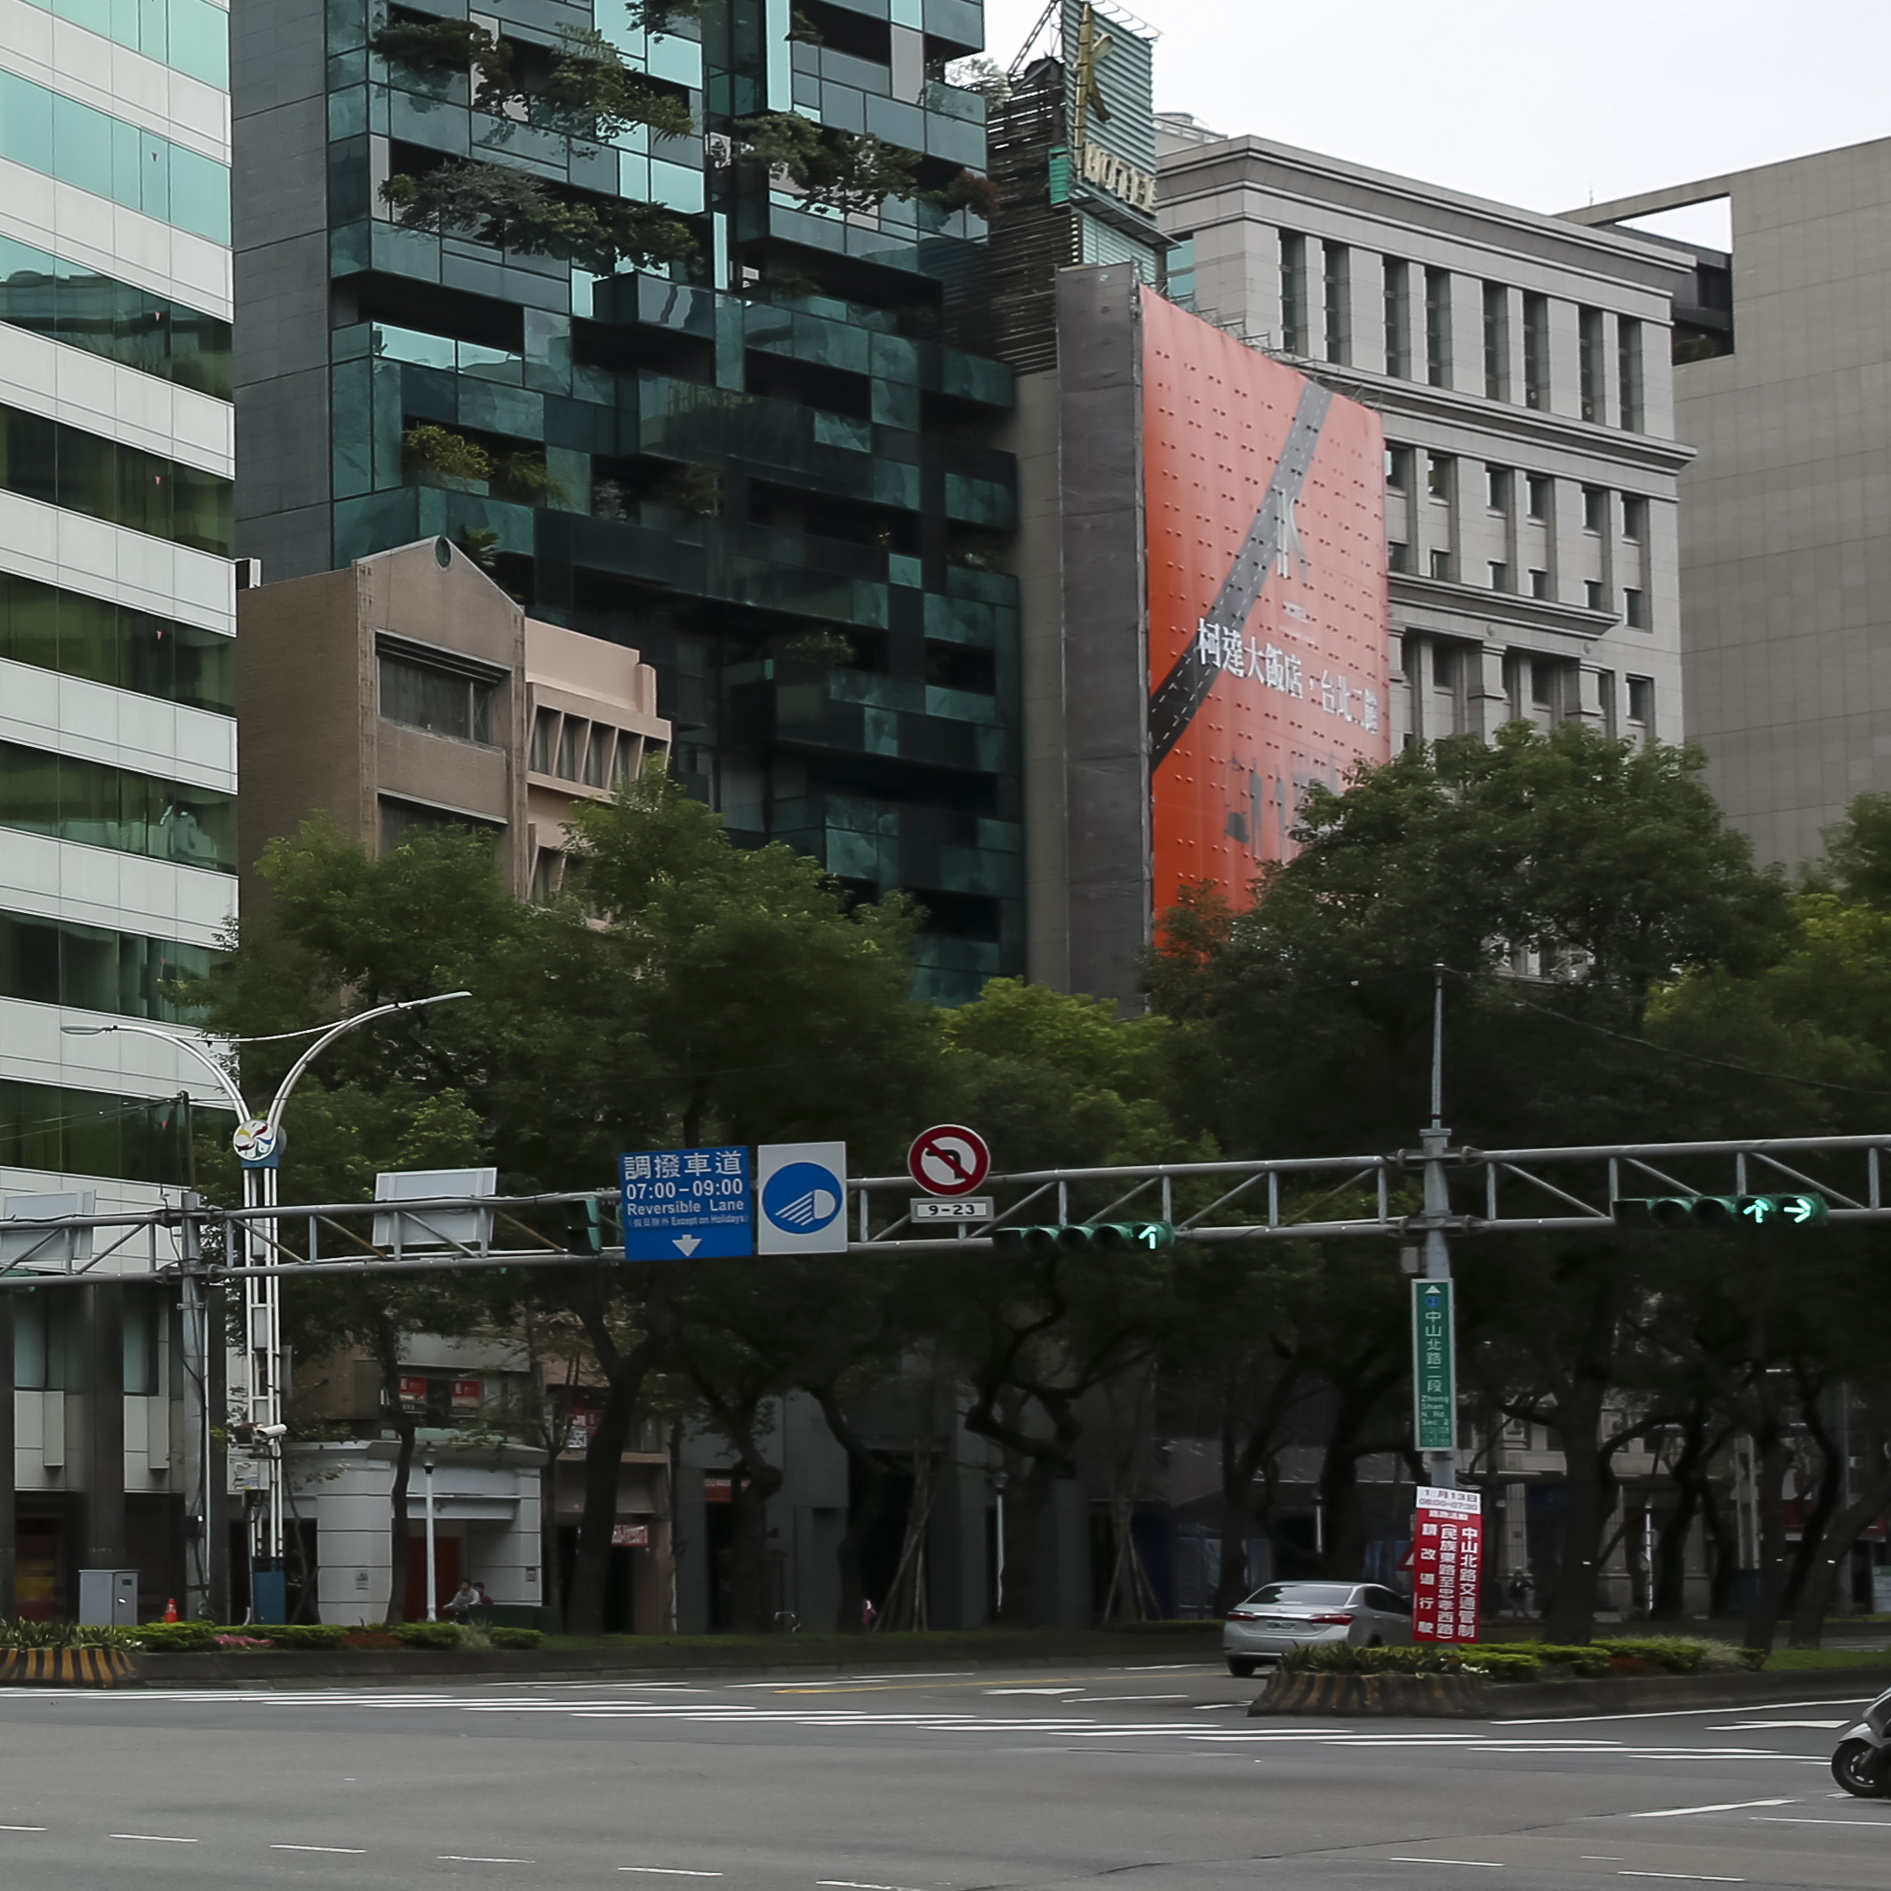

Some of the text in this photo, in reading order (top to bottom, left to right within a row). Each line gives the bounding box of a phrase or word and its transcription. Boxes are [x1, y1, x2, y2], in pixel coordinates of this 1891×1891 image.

[624, 1150, 742, 1180] 調撥車道
[627, 1199, 744, 1215] Reversible Lane
[928, 1204, 975, 1216] 9-23
[671, 1216, 697, 1226] Except
[1425, 1311, 1442, 1392] 中山北路二段
[1458, 1527, 1477, 1637] 中山北路交通管制
